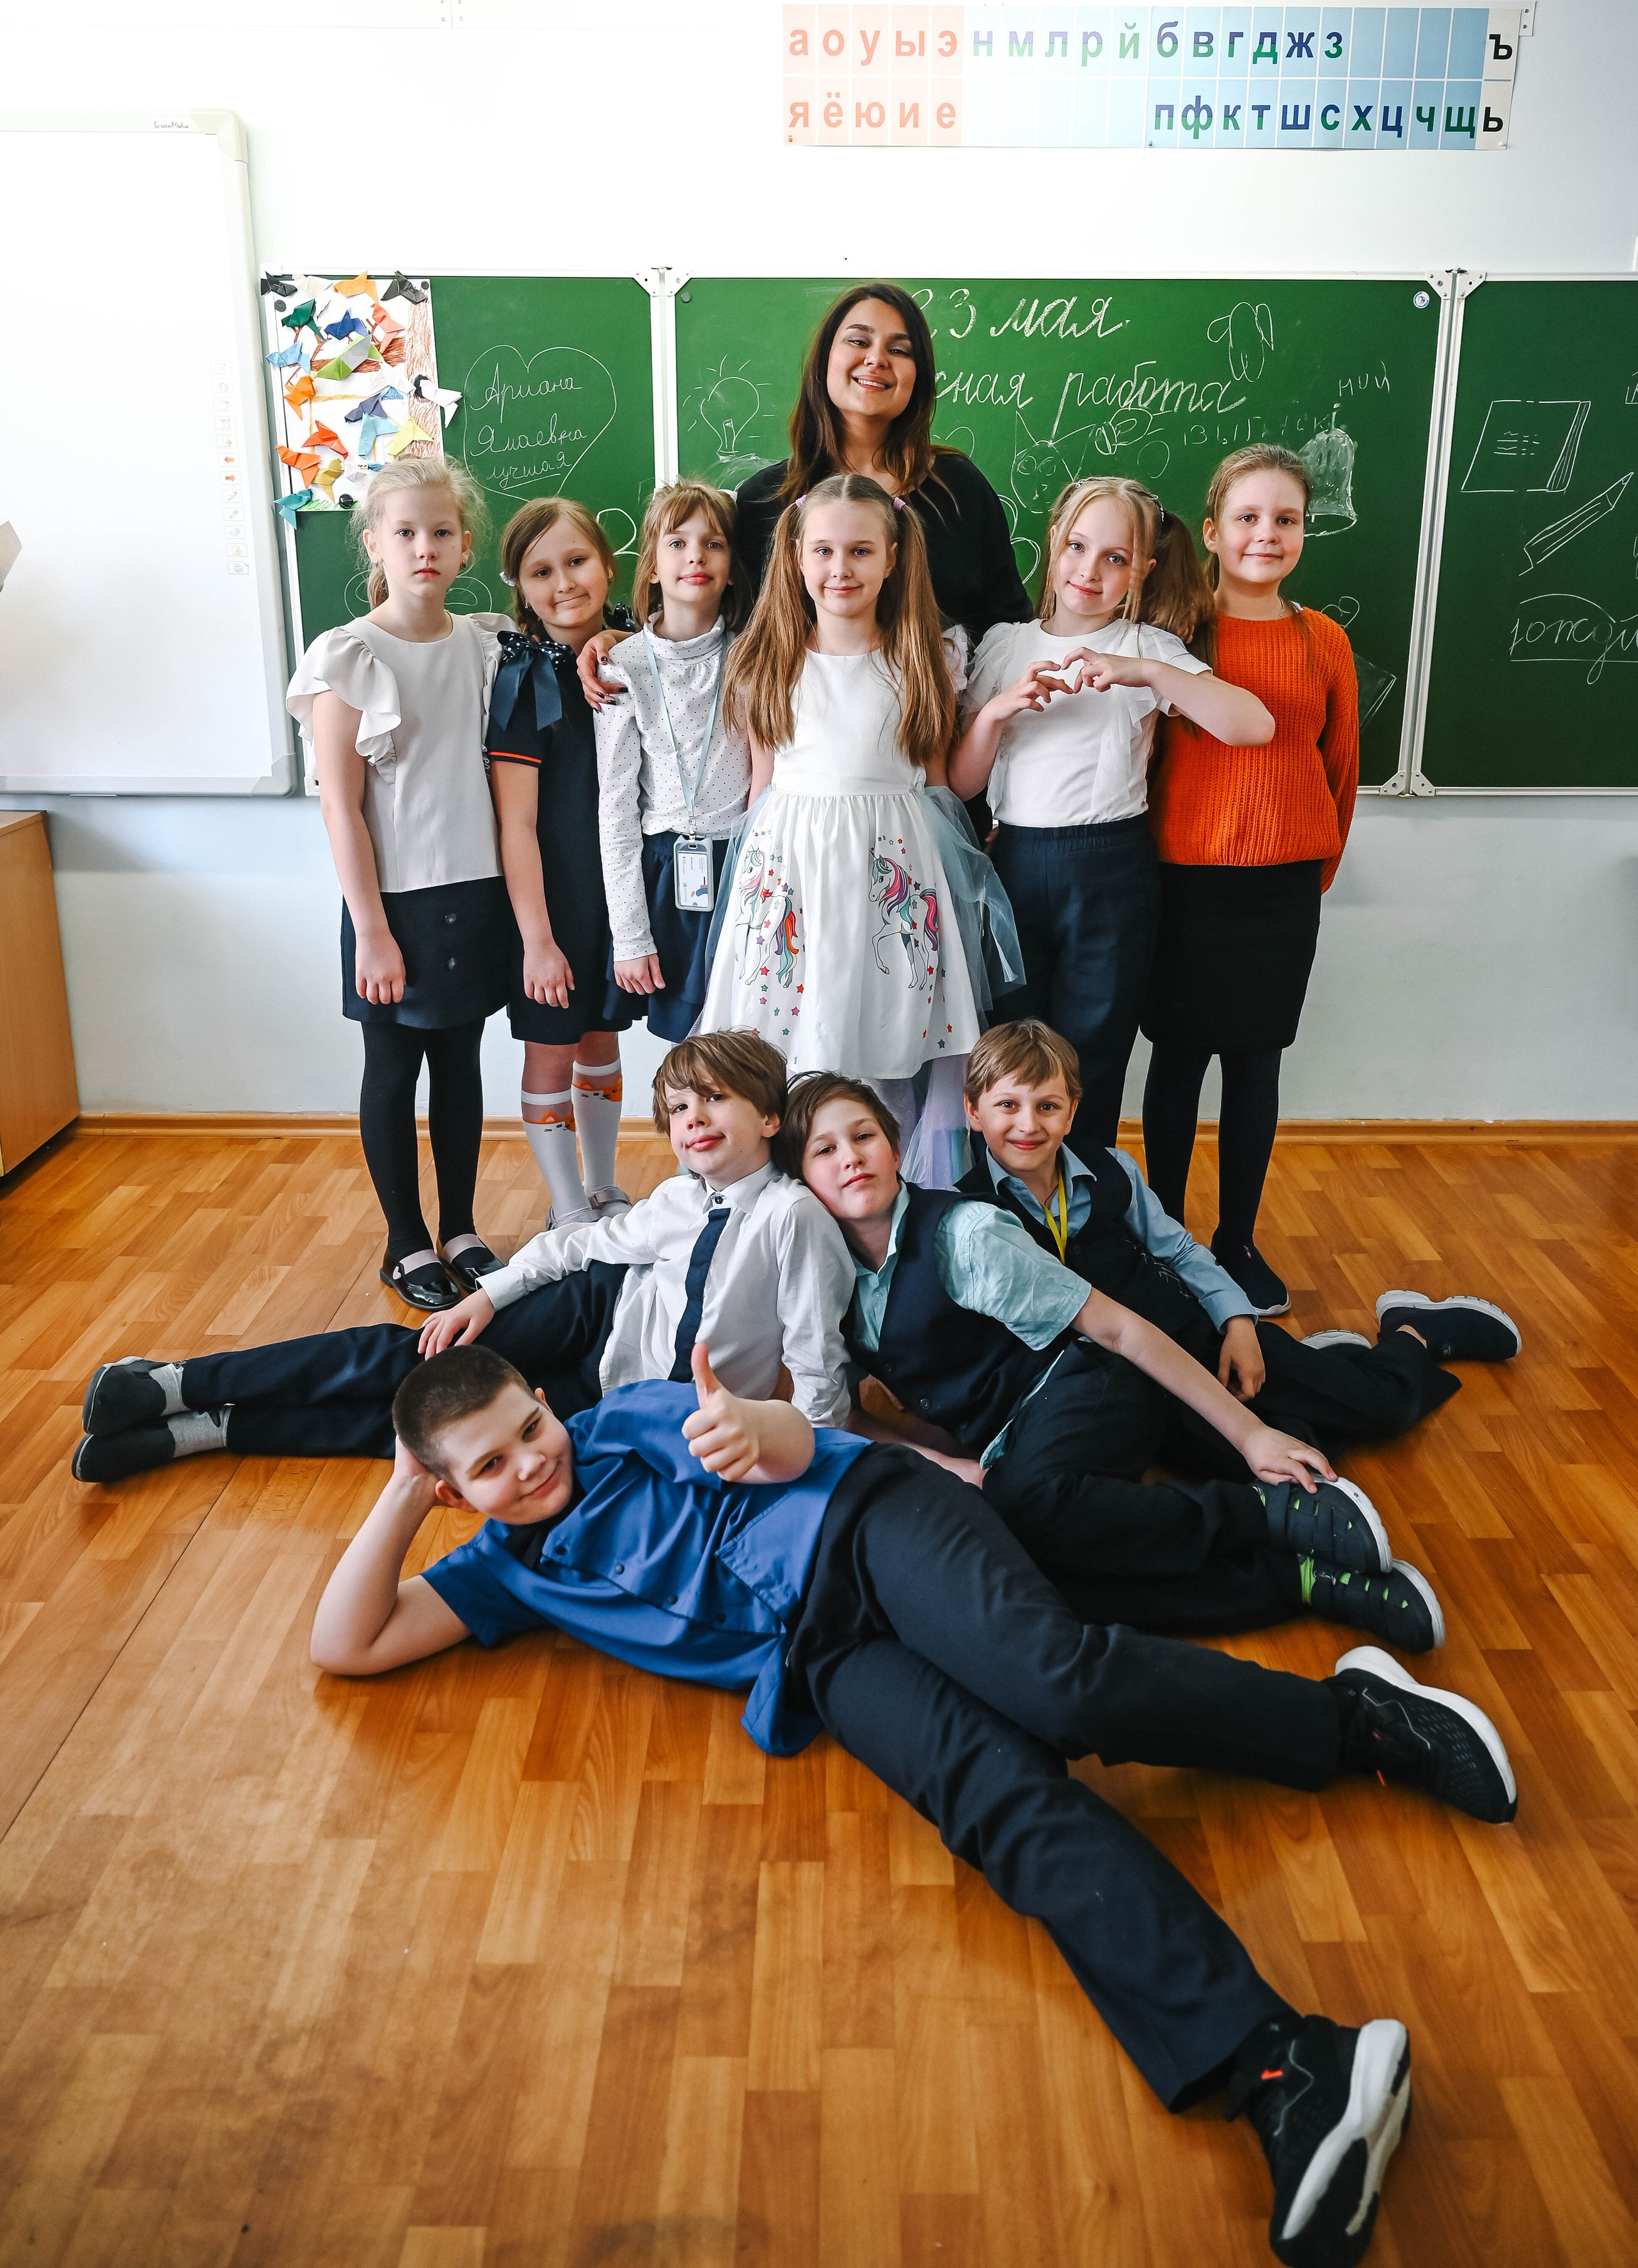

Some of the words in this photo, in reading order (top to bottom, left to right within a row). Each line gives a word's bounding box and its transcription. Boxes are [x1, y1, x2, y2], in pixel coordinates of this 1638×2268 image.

[470, 362, 583, 424] Ариана
[1052, 360, 1247, 440] работа
[470, 413, 587, 457] Ямаевна
[486, 451, 571, 488] лучшая
